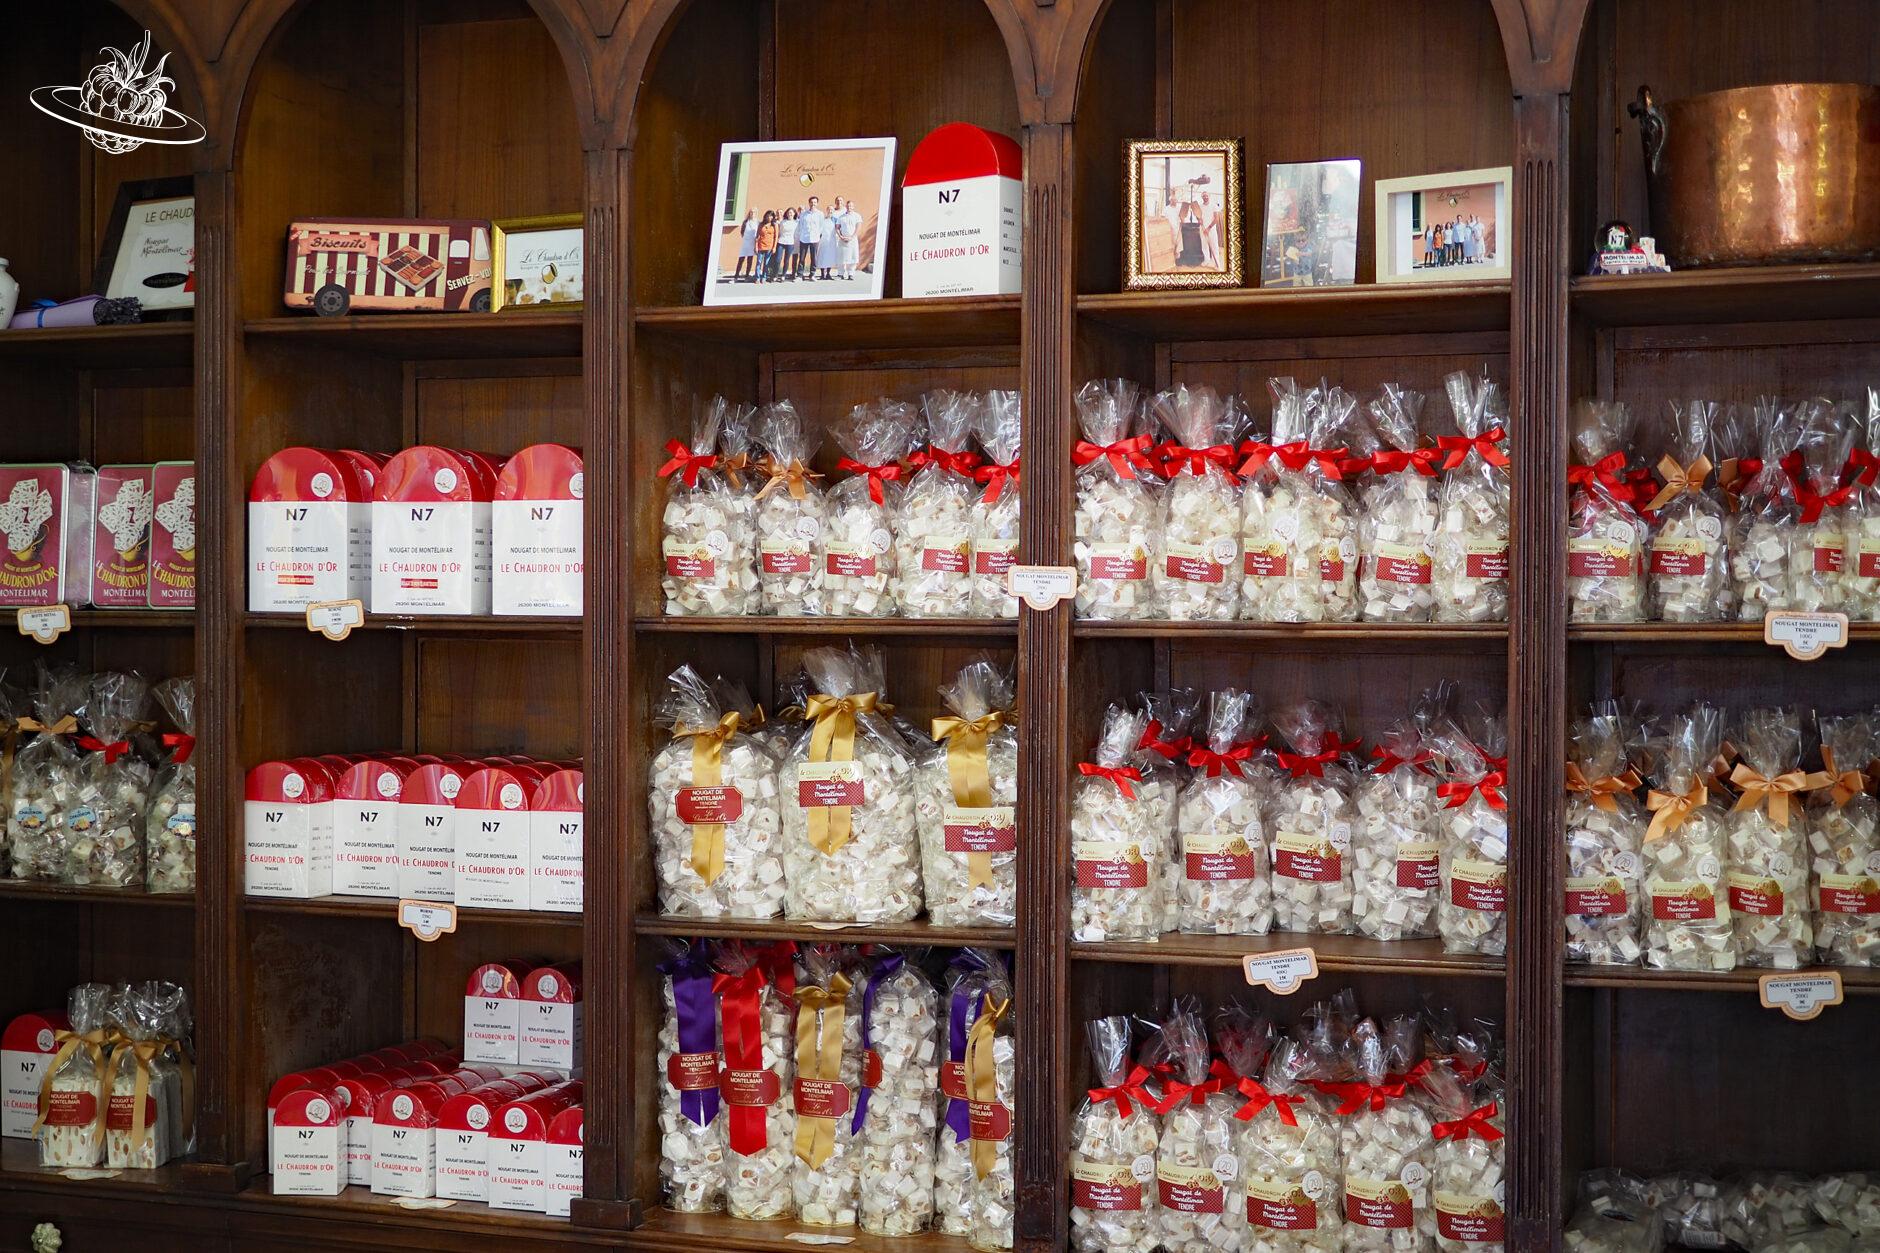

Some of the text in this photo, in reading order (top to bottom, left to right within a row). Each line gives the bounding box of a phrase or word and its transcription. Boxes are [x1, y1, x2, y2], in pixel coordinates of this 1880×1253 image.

[939, 189, 960, 204] N7
[145, 207, 195, 223] LE CHAUD
[919, 232, 939, 240] NOUGAT
[940, 231, 947, 239] DE
[310, 237, 367, 249] Biscuits
[910, 244, 990, 261] LE CHAUDRON D'OR
[286, 508, 309, 521] N7
[411, 508, 434, 521] N7
[531, 507, 554, 521] N7
[257, 561, 338, 571] LE CHAUDRON D'OR
[379, 562, 461, 573] LE CHAUDRON D'OR
[501, 562, 561, 573] LE CHAUDRON
[265, 812, 283, 823] N7
[360, 812, 379, 822] N7
[425, 816, 444, 827] N7
[482, 822, 500, 833] N7
[560, 824, 578, 835] N7
[250, 854, 305, 865] CHAUDRON D'OR
[347, 853, 383, 863] CHAUDRON
[402, 858, 449, 868] LE CHAUDRON
[458, 864, 525, 876] LE CHAUDRON D'OR
[534, 868, 542, 876] LE
[1252, 959, 1272, 967] NOUGAT
[485, 1001, 499, 1010] N7
[540, 1006, 553, 1014] N7
[475, 1032, 501, 1040] CHAUDRON
[529, 1036, 556, 1044] CHAUDRON
[21, 1062, 36, 1073] N7
[680, 1060, 715, 1068] MONTELIMAR
[802, 1081, 821, 1089] NOUGAT
[298, 1130, 315, 1139] N7
[393, 1130, 407, 1139] N7
[458, 1135, 473, 1144] N7
[510, 1144, 525, 1153] N7
[569, 1150, 583, 1159] N7
[286, 1163, 317, 1171] CHAUDRON
[382, 1162, 408, 1172] CHAUDRON
[447, 1167, 475, 1176] CHAUDRON
[499, 1176, 529, 1185] CHAUDRON
[1271, 1220, 1288, 1228] TENDRE
[1367, 1218, 1385, 1226] TENDRE
[1460, 1232, 1478, 1240] TENDRE
